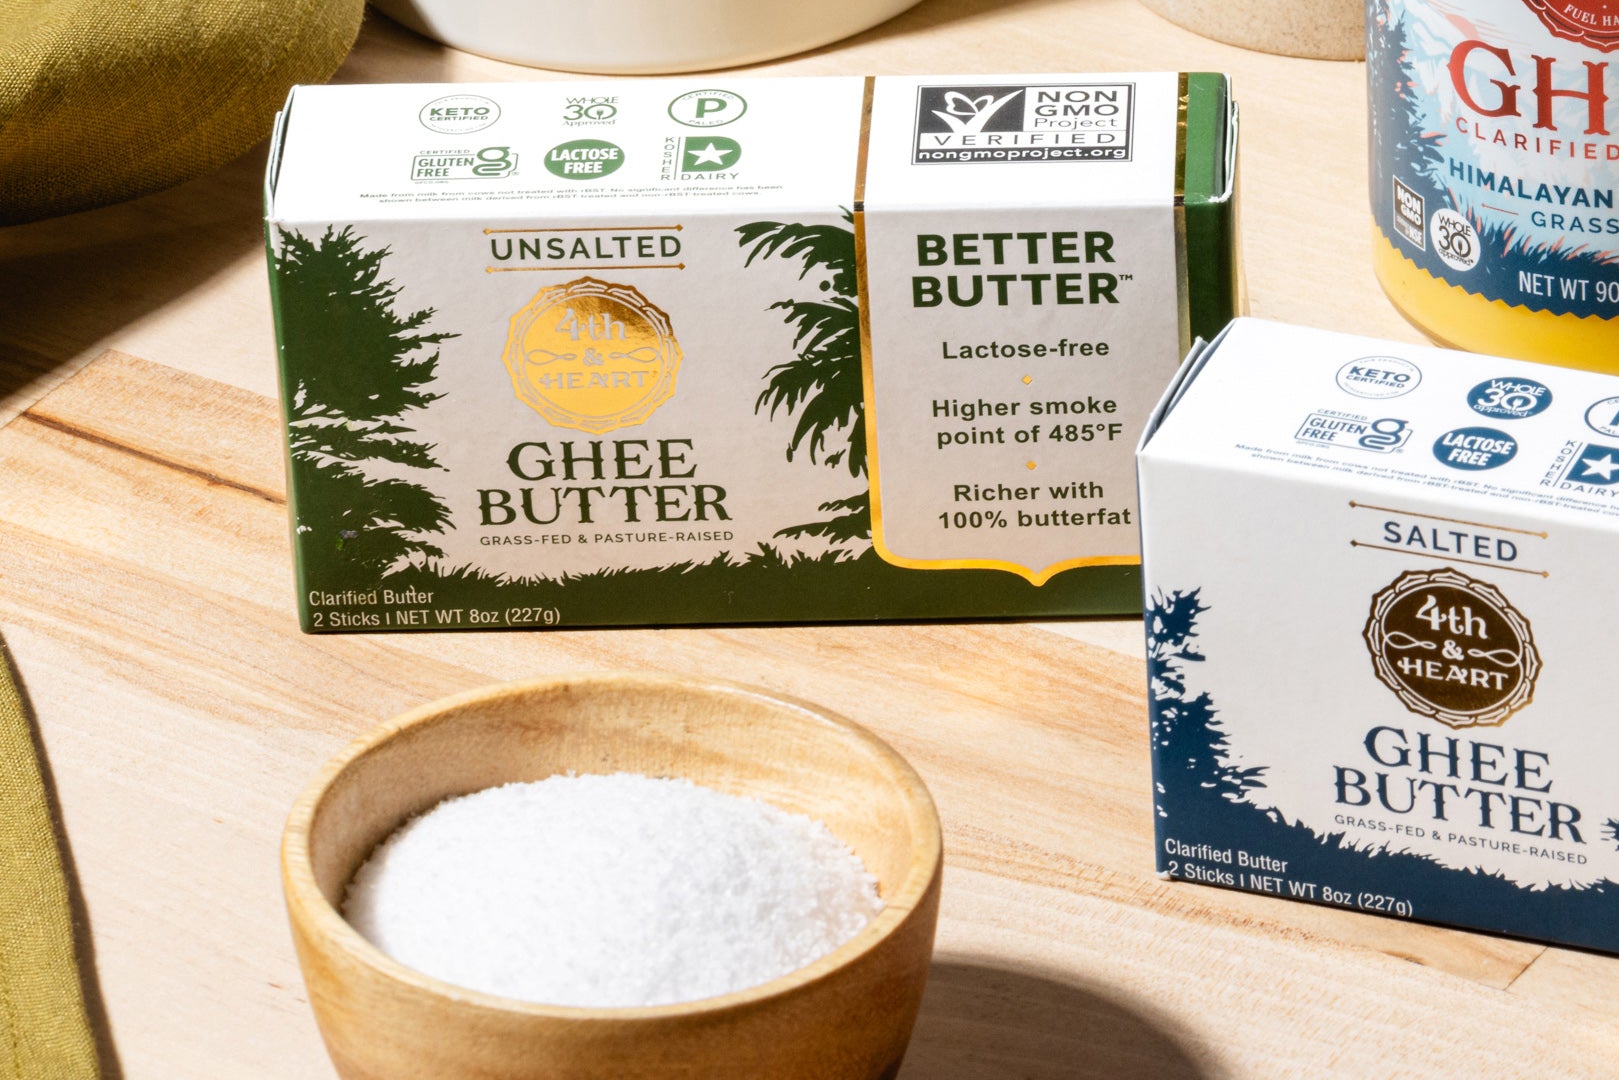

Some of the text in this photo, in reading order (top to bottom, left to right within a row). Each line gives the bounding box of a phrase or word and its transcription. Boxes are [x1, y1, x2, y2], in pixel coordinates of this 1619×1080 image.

[1563, 5, 1598, 26] FUEL
[1036, 90, 1118, 103] NON
[430, 107, 490, 116] KETO
[1034, 103, 1119, 117] GMO
[1034, 116, 1117, 130] Project
[934, 131, 1116, 146] VERIFIED
[418, 157, 474, 167] GLUTEN
[551, 148, 618, 161] LACTOSE
[918, 145, 1126, 161] nongmoproject.org
[416, 168, 450, 177] FREE
[564, 161, 603, 174] FREE
[681, 172, 740, 181] DAIRY
[1449, 157, 1613, 209] HIMALAYAN
[490, 235, 681, 261] UNSALTED
[917, 231, 1115, 267] BETTER
[1519, 271, 1554, 297] NET
[1560, 278, 1589, 301] WT
[555, 308, 628, 342] 4th
[942, 340, 1110, 360] Lactose-free
[1348, 366, 1410, 383] KETO
[1491, 379, 1546, 397] WHOLE
[932, 396, 1117, 421] Higher smoke
[1302, 428, 1338, 441] FREE
[1309, 417, 1367, 435] GLUTEN
[937, 427, 1005, 449] point
[1016, 425, 1040, 444] of
[1442, 432, 1515, 455] LACTOSE
[505, 439, 698, 481] GHEE
[1448, 450, 1492, 467] FREE
[953, 482, 1103, 502] Richer with
[477, 484, 733, 526] BUTTER
[938, 508, 1131, 529] 100% butterfat
[480, 530, 735, 546] GRASS-FED PASTURE-RAISED
[1384, 520, 1518, 562] SALTED
[308, 587, 434, 607] Clarified Butter
[330, 607, 561, 627] Sticks NET WT 8oz (227g)
[1415, 594, 1488, 639] 4th
[1398, 657, 1509, 692] HEART
[1363, 725, 1554, 794] GHEE
[1333, 765, 1587, 844] BUTTER
[1334, 814, 1588, 866] GRASS-FED PASTURE-RAISED
[1165, 838, 1288, 873] Clarified Butter
[1184, 864, 1413, 918] Sticks NET WT 8oz (227g)
